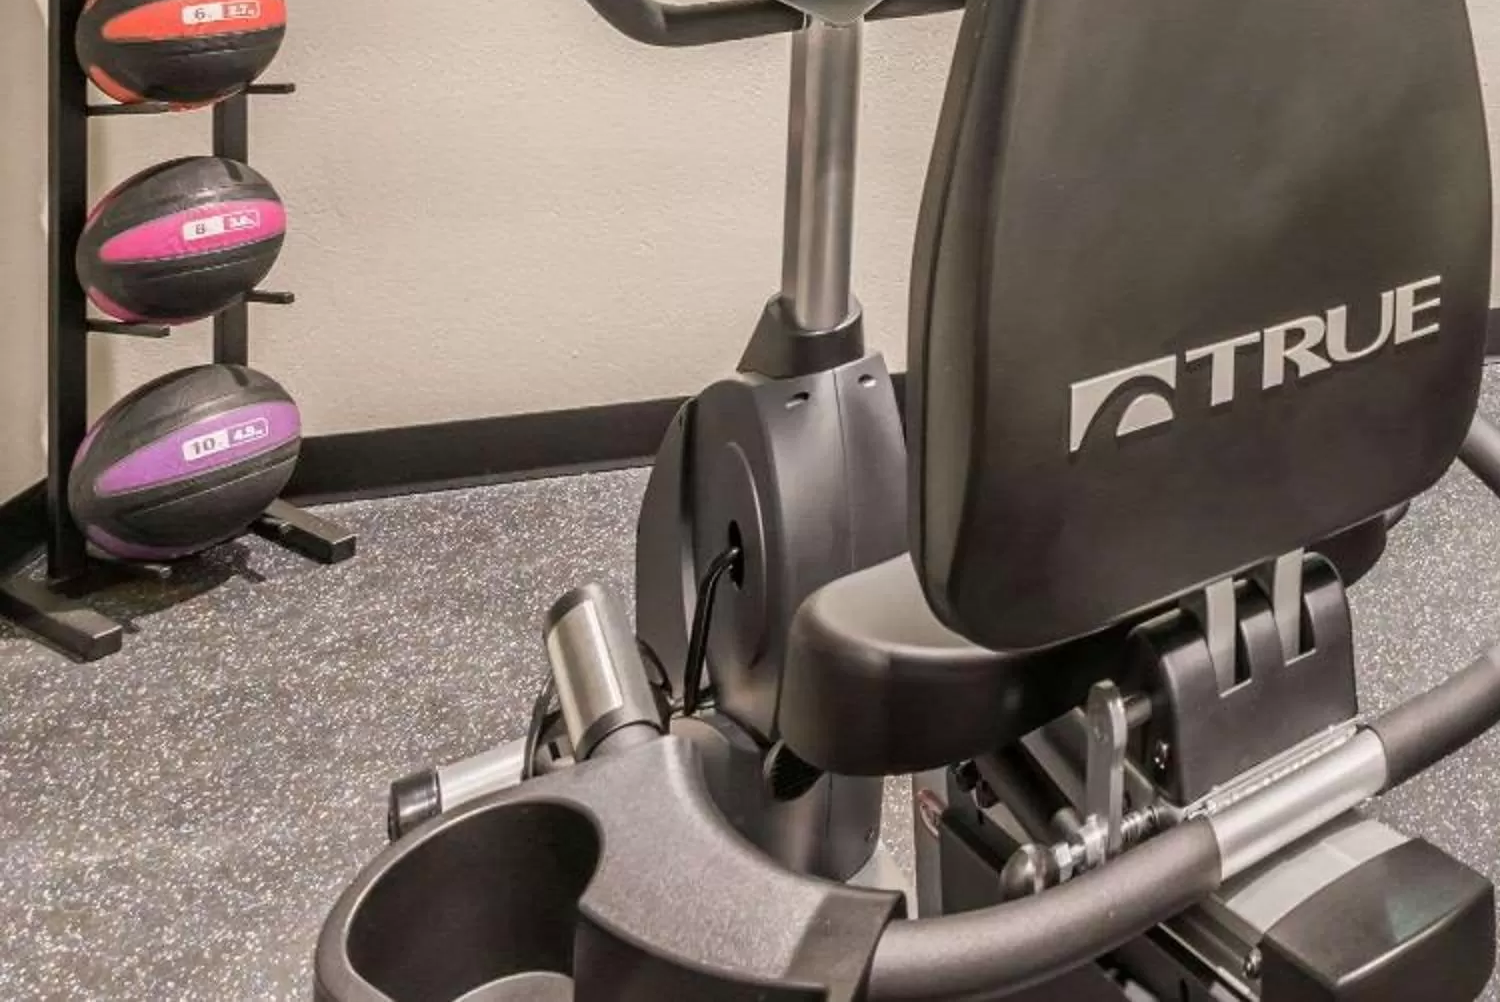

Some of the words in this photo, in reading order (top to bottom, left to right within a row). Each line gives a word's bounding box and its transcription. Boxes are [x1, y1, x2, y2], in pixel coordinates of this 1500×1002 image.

[195, 7, 206, 20] 6
[1185, 275, 1441, 406] TRUE
[192, 437, 215, 455] 10
